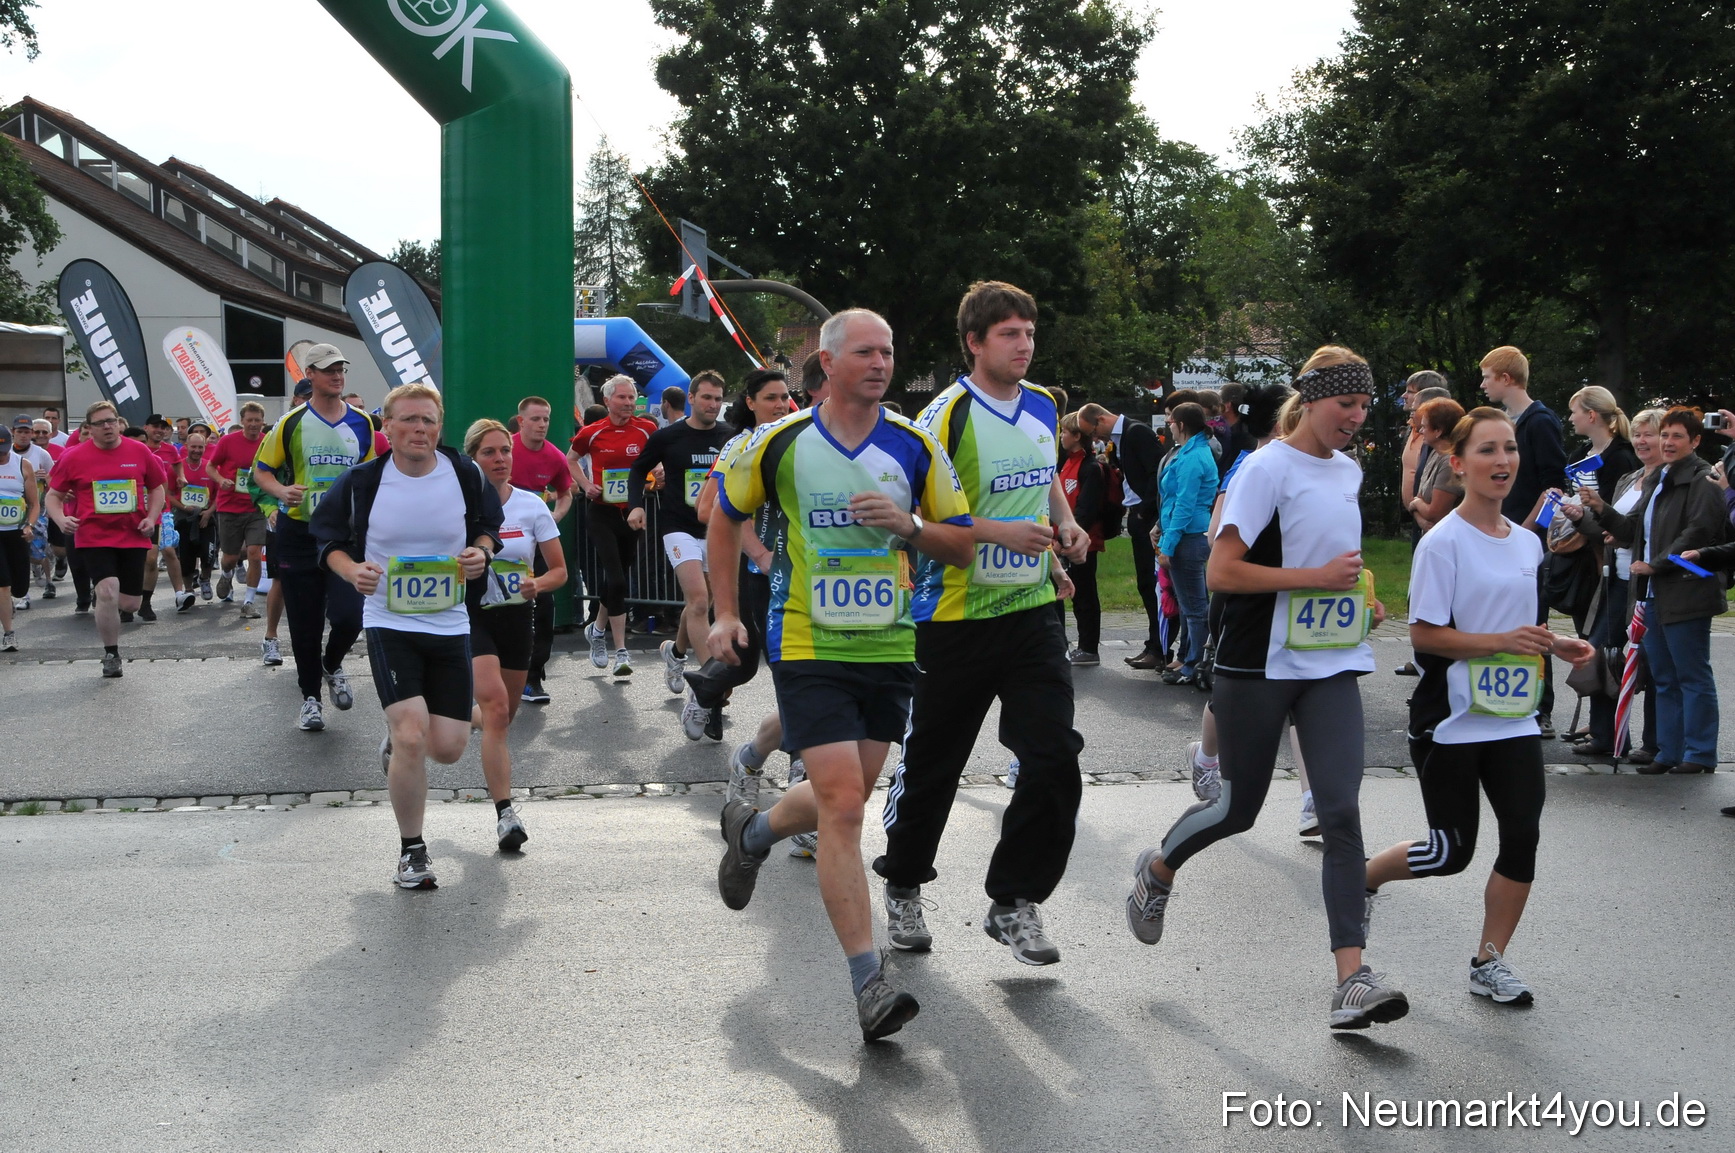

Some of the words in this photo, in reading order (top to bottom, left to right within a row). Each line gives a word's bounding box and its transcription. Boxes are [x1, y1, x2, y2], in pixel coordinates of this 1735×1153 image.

[310, 446, 340, 454] TEAM
[309, 454, 355, 467] BOCK
[992, 454, 1034, 473] TEAM
[607, 480, 628, 495] 75
[990, 465, 1056, 494] BOCK
[99, 491, 128, 505] 329
[184, 492, 204, 503] 345
[392, 577, 450, 598] 1021
[814, 578, 893, 607] 1066
[1296, 597, 1355, 629] 479
[1310, 630, 1329, 638] Jessi
[1477, 667, 1529, 697] 482
